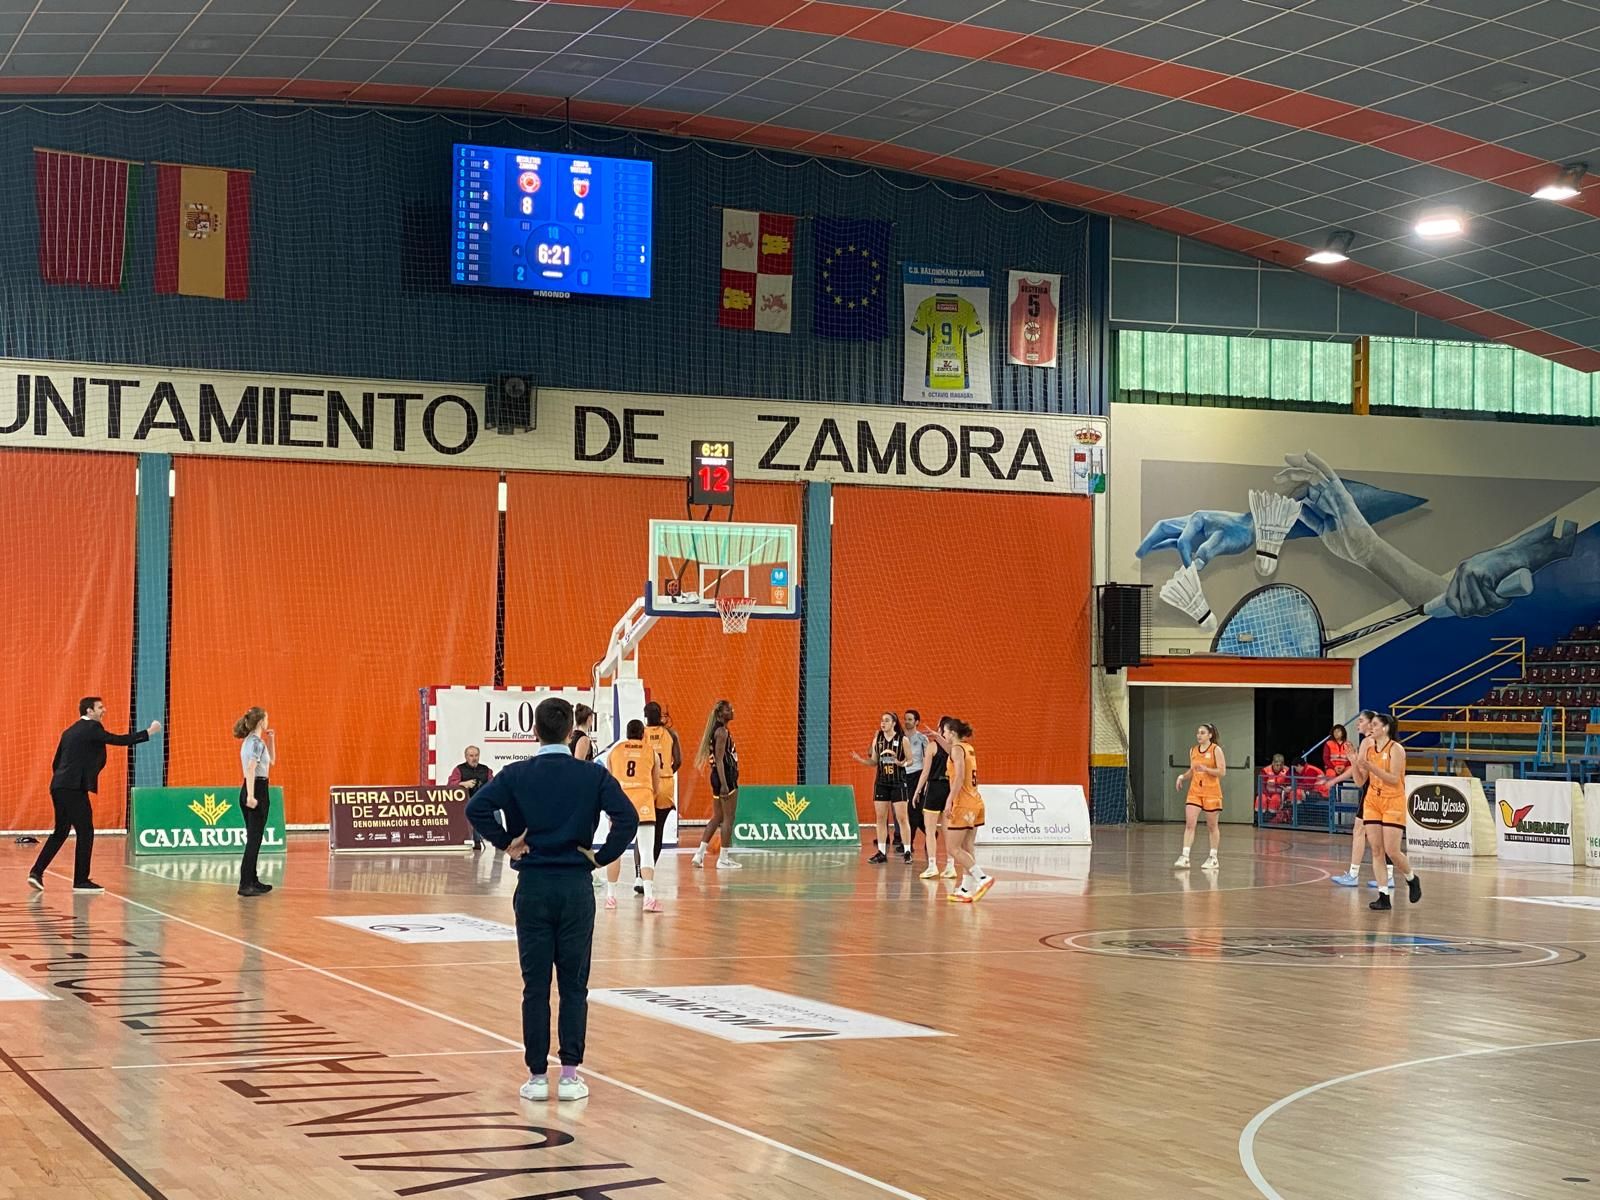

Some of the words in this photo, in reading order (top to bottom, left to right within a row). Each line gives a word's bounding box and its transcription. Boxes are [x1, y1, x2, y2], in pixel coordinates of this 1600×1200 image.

[522, 196, 532, 215] 8
[574, 202, 584, 220] 4
[538, 243, 570, 266] 6:21
[539, 290, 571, 298] MONDO
[1028, 294, 1041, 318] 5
[941, 322, 952, 346] 9
[574, 406, 664, 465] DE
[757, 414, 1053, 482] ZAMORA
[701, 443, 729, 457] 6:21
[699, 466, 730, 492] 12
[485, 701, 511, 732] La
[626, 760, 636, 777] 8
[331, 791, 390, 804] TIERRA
[394, 790, 424, 803] DEL
[426, 789, 466, 802] VINO
[352, 806, 373, 818] DE
[378, 804, 447, 818] ZAMORA
[1441, 795, 1466, 817] Iglesias
[410, 818, 420, 826] DE
[422, 818, 449, 826] ORIGEN
[991, 823, 1041, 834] recoletas
[1044, 823, 1071, 834] salud
[139, 828, 199, 848] CAJA
[734, 823, 786, 841] CAJA
[785, 823, 857, 840] RURAL
